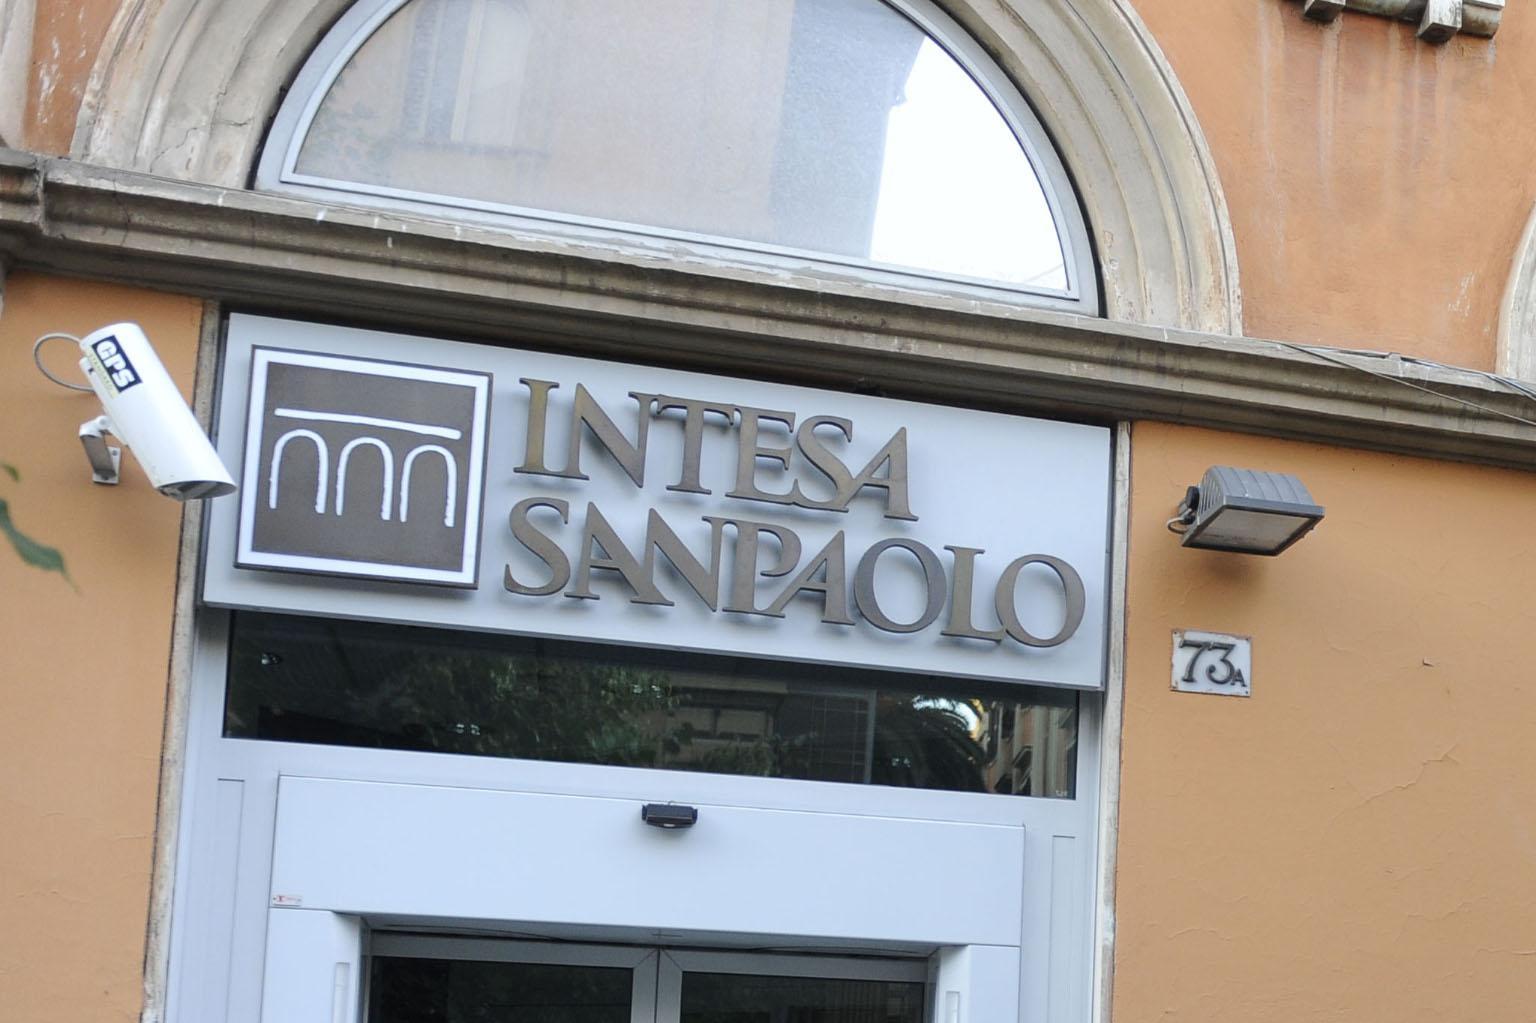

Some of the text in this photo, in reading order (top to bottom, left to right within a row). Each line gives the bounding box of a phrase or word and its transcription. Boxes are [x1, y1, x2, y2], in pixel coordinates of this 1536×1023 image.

[96, 340, 136, 388] GPS
[513, 377, 919, 522] INTESA
[503, 496, 1087, 649] SANPAOLO
